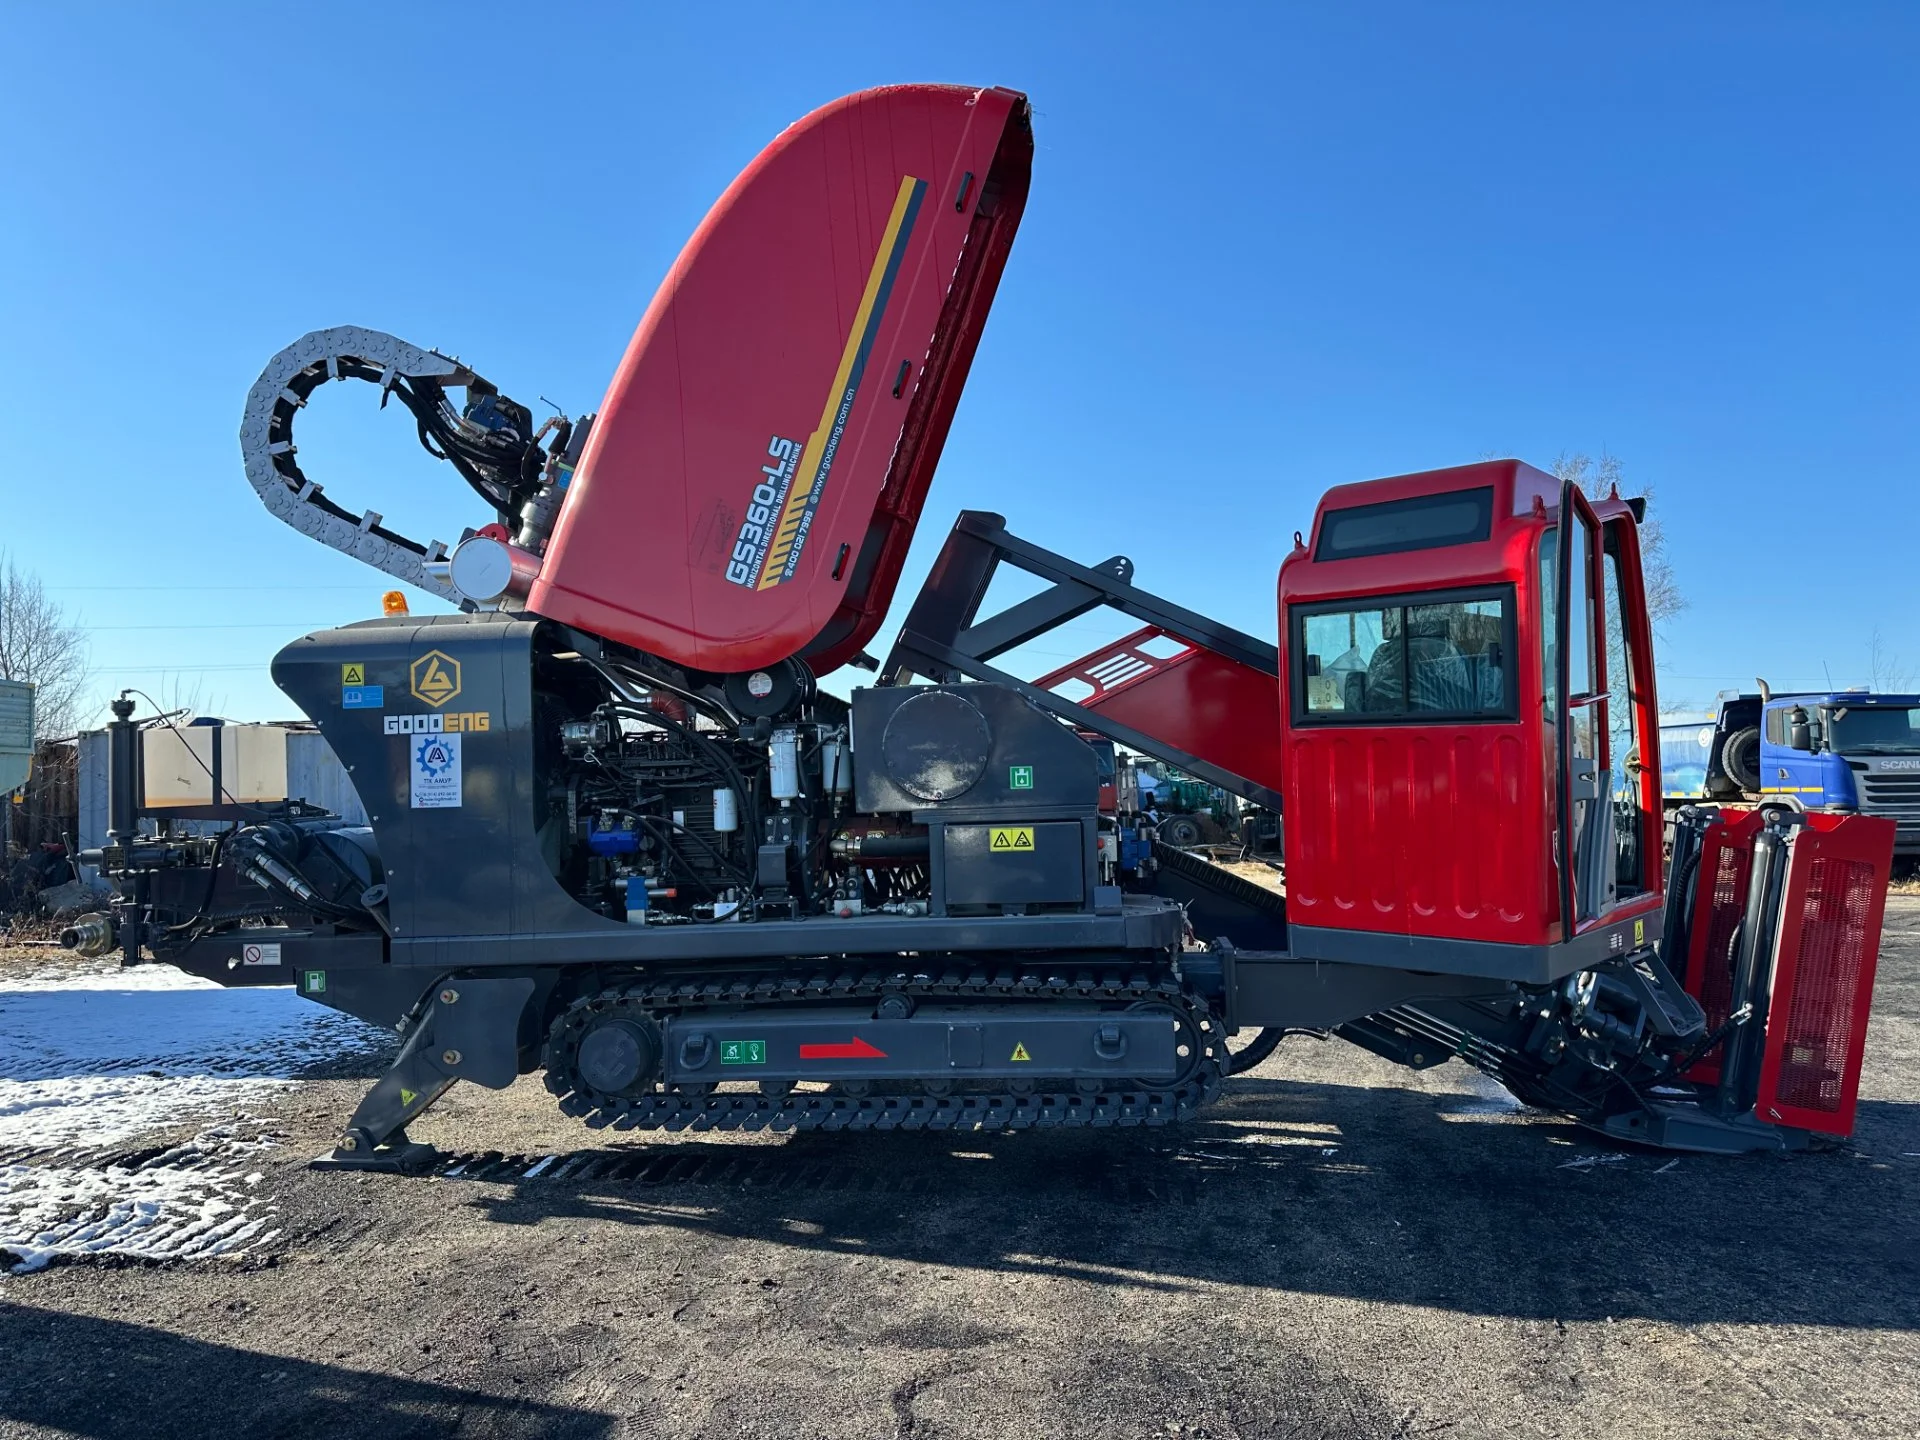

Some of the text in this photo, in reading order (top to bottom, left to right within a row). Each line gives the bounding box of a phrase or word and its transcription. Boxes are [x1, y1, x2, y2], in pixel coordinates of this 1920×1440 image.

[813, 388, 855, 495] www.goodeng.com.cn
[725, 435, 793, 585] GS360-LS
[746, 442, 803, 589] HORIZONTAL DIRECTIONAL DRILLING MACHINE
[788, 550, 799, 569] 400
[799, 510, 813, 534] 7999
[383, 712, 490, 735] GOODENG
[1880, 760, 1920, 769] SCANI
